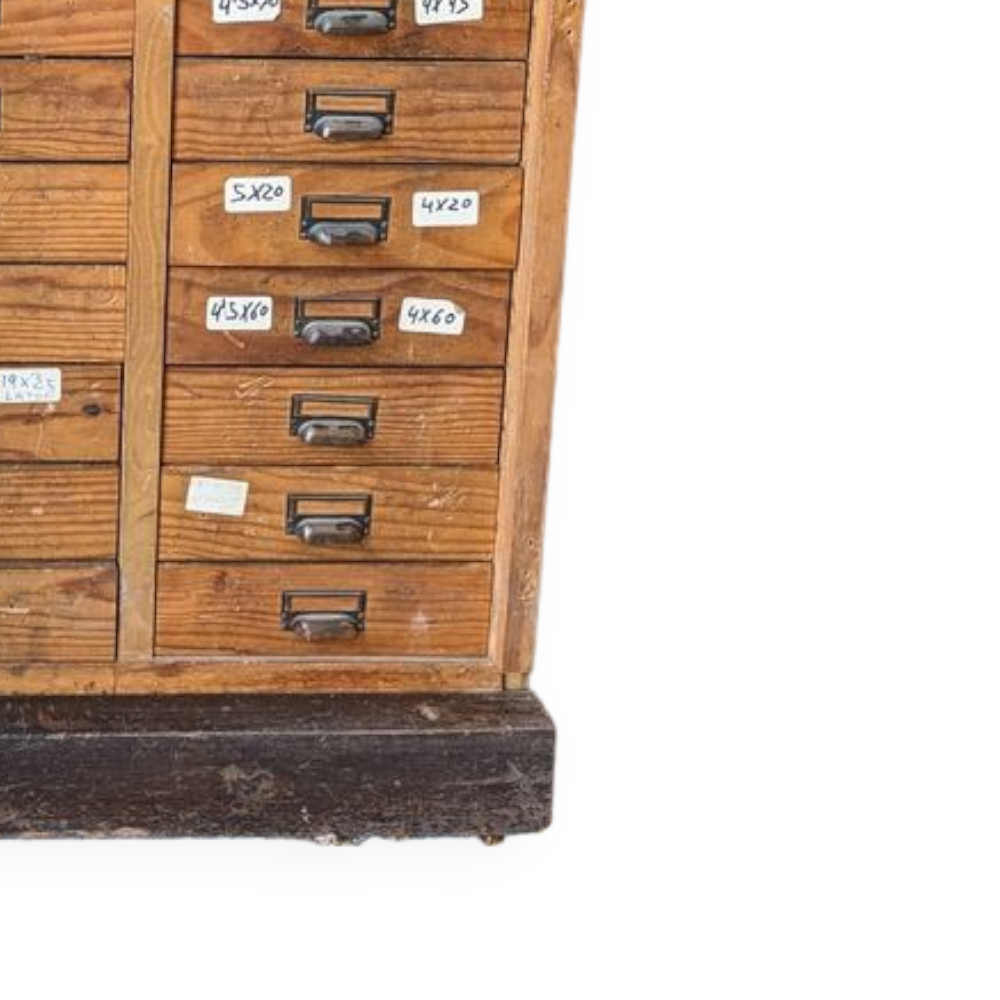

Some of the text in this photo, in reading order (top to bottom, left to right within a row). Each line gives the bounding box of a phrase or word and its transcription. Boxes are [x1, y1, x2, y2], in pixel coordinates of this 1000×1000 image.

[230, 183, 283, 202] 5X20
[421, 198, 472, 213] 4X20
[407, 306, 455, 325] 4X60
